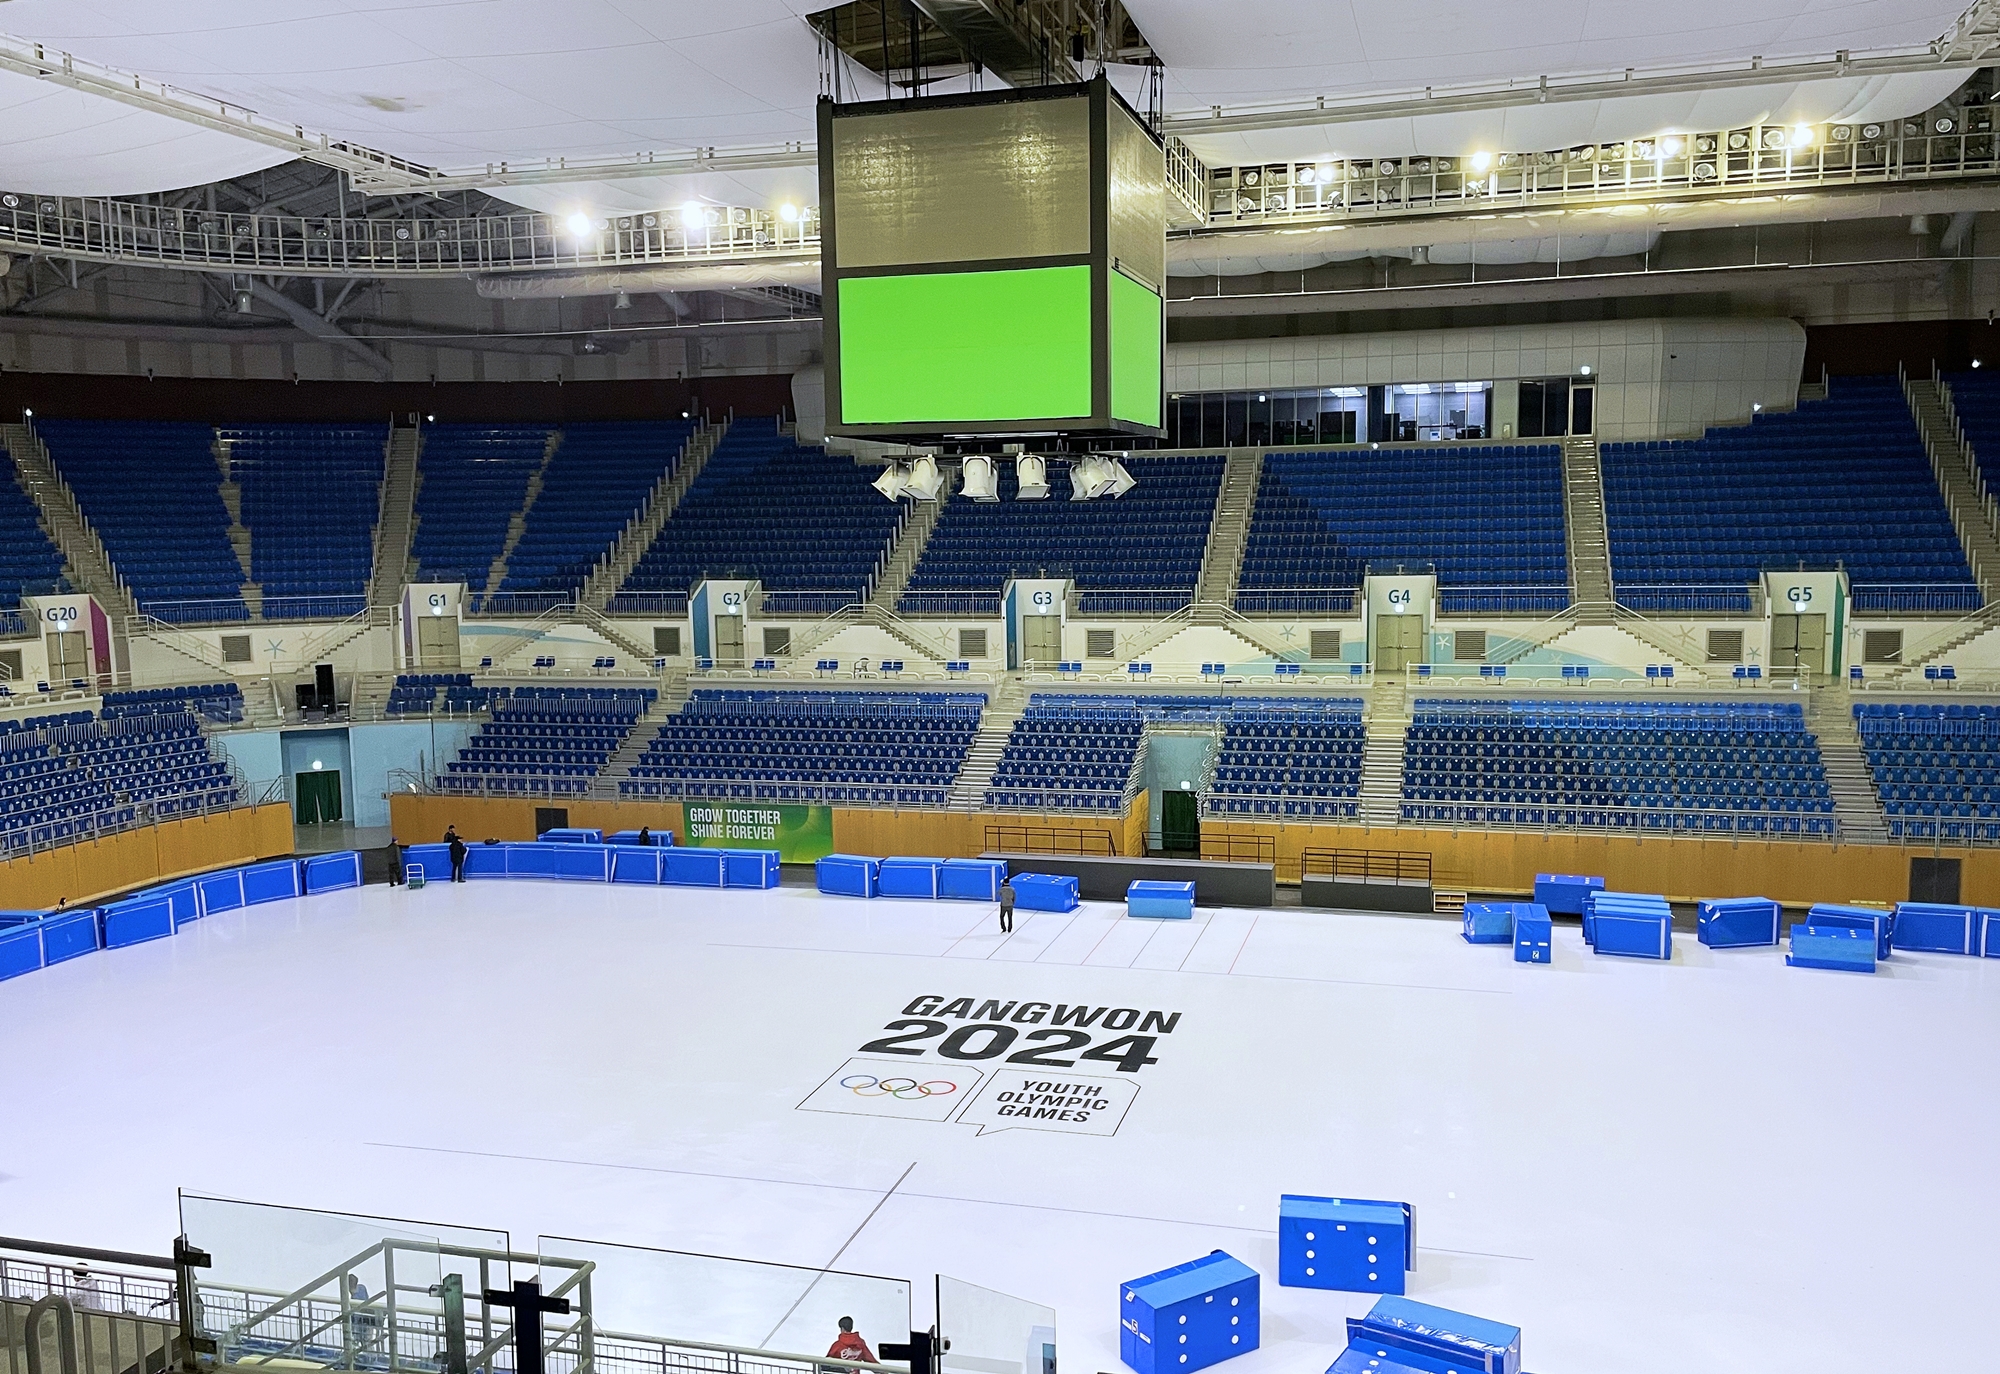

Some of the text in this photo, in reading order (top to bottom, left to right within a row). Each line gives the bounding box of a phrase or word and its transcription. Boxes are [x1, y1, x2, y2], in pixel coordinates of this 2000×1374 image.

[428, 594, 446, 606] G1
[723, 593, 741, 605] G2
[1033, 592, 1051, 604] G3
[1389, 589, 1411, 603] G4
[1788, 587, 1812, 601] G5
[46, 607, 77, 621] G20
[691, 807, 780, 825] GROW TOGETHER
[692, 824, 775, 840] SHINE FOREVER
[901, 995, 1182, 1033] GANGWON
[858, 1019, 1159, 1072] 2024
[1023, 1080, 1102, 1096] YOUTH
[997, 1091, 1109, 1110] OLYMPIC
[997, 1104, 1091, 1122] GAMES
